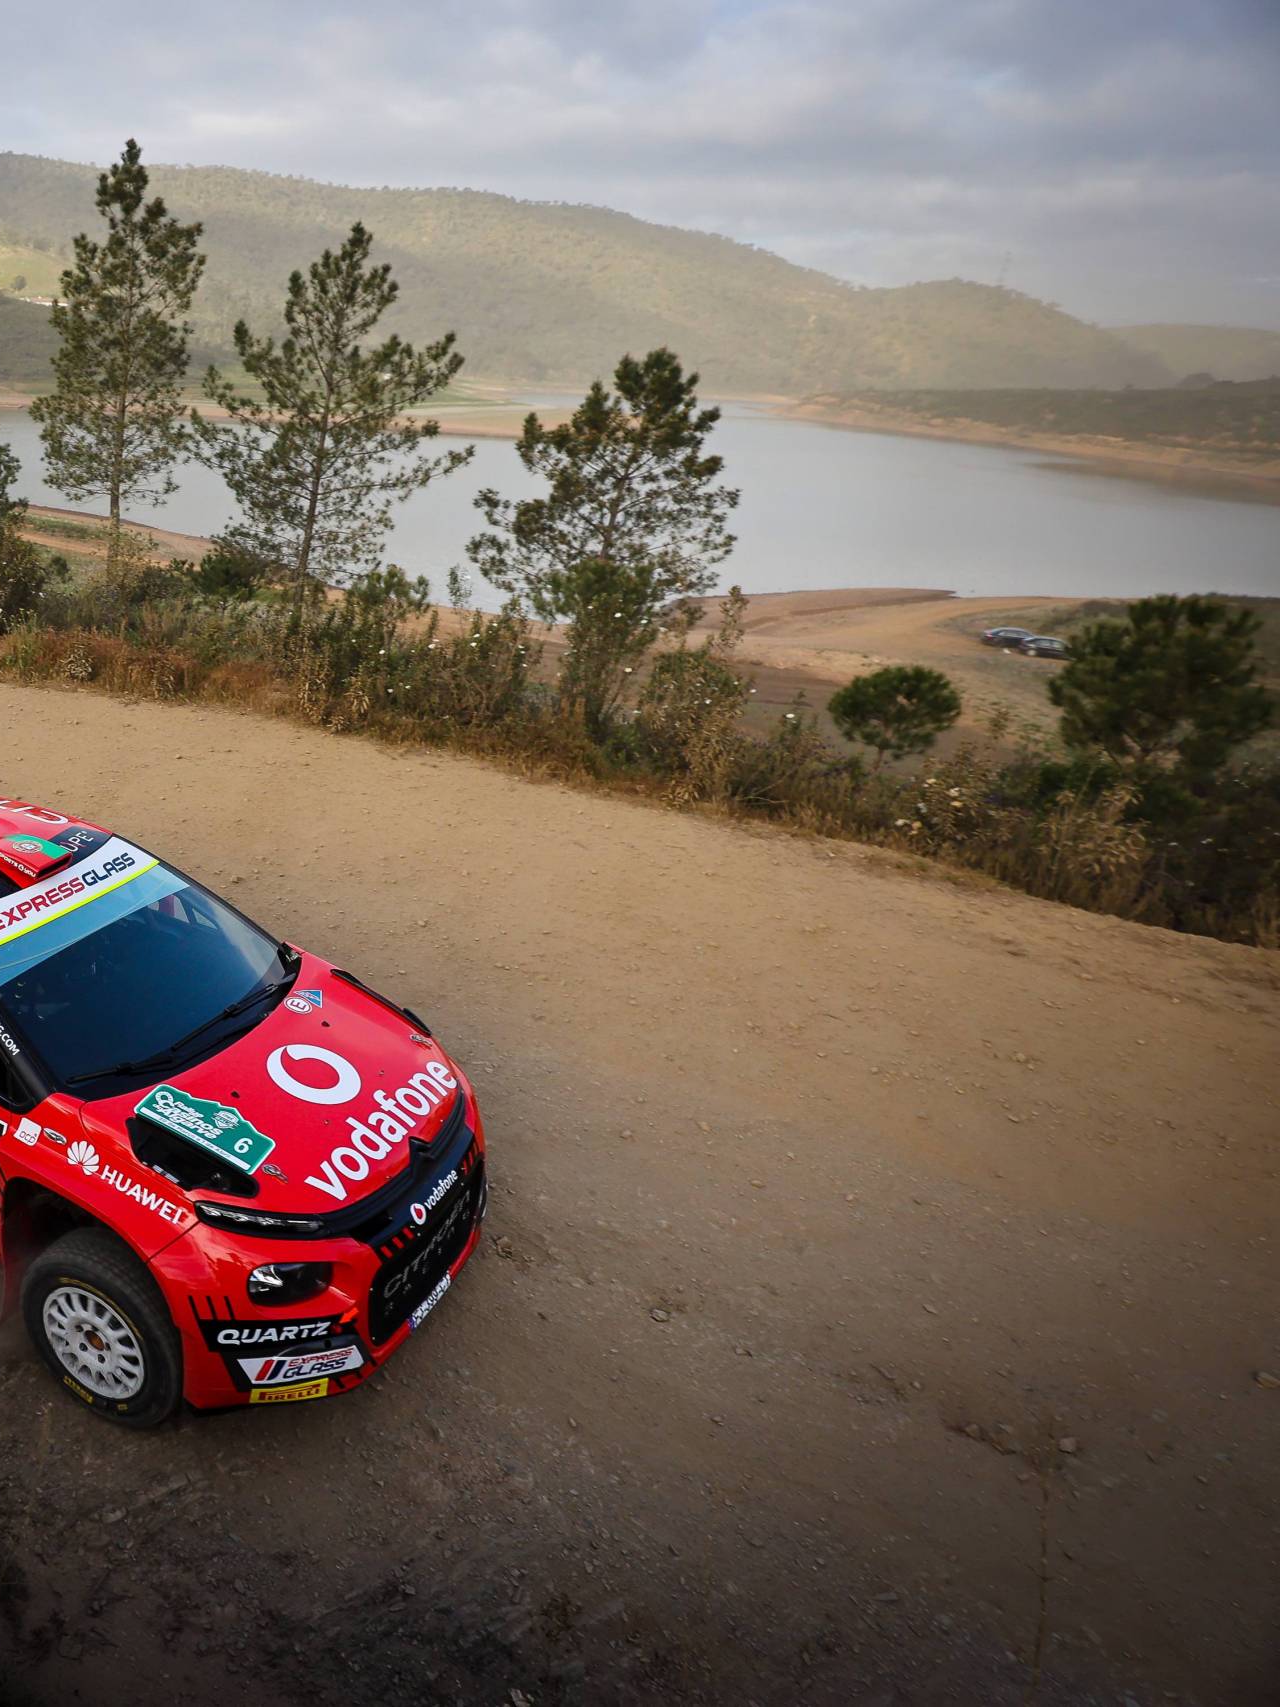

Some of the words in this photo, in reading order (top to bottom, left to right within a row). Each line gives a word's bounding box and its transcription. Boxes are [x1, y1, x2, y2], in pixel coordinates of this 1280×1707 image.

[158, 1099, 223, 1136] Casinos
[162, 1106, 217, 1139] Algarve
[303, 1061, 458, 1201] vodafone
[233, 1137, 253, 1154] 6
[100, 1164, 183, 1225] HUAWEI
[424, 1170, 459, 1211] vodafone
[217, 1321, 332, 1345] QUARTZ
[283, 1357, 348, 1379] GLASS
[288, 1347, 355, 1368] EXPRESS
